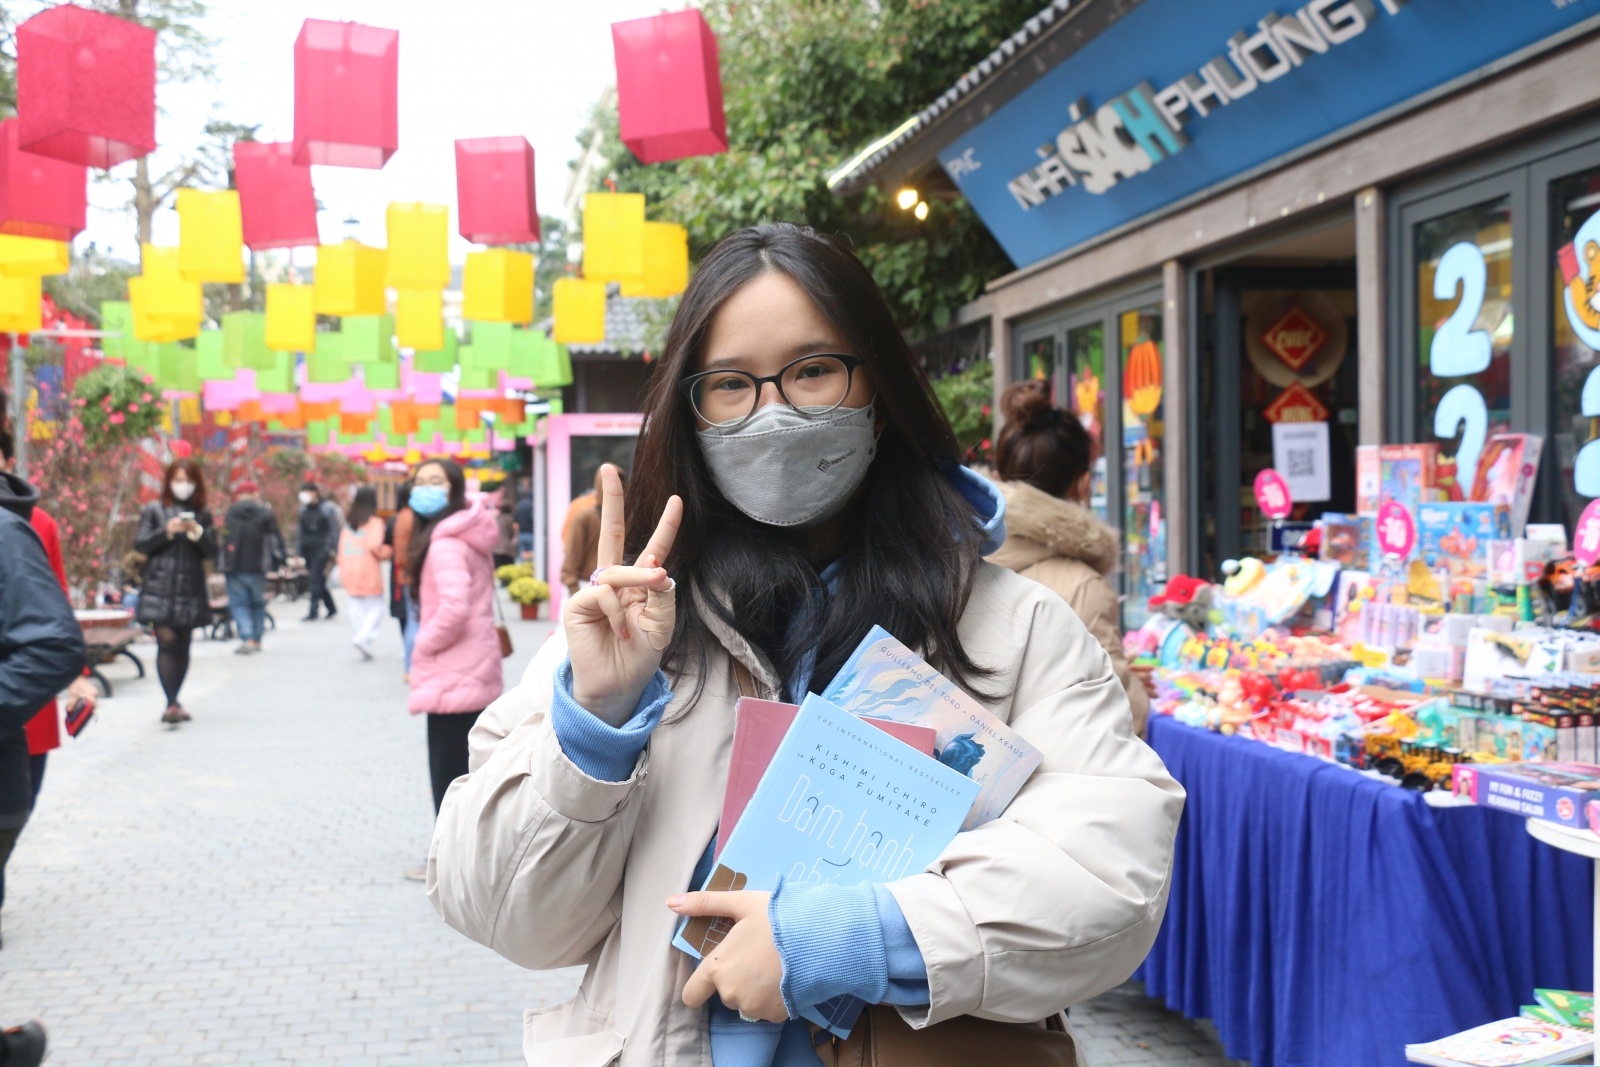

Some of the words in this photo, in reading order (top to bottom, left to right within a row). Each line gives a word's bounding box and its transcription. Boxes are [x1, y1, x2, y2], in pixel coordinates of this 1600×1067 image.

[1007, 145, 1077, 211] NHÀ
[1057, 86, 1183, 195] SÁCH
[1153, 0, 1367, 132] PHƯƠNG
[1430, 241, 1492, 377] 2
[880, 646, 924, 681] GUILLERMO
[924, 679, 938, 693] DEL
[940, 691, 961, 711] TORO
[969, 714, 997, 739] DANIEL
[998, 737, 1025, 759] KRAUS
[809, 756, 846, 781] KOGA
[856, 781, 931, 827] FUMITAKE
[815, 743, 876, 781] KISHIMI
[885, 781, 938, 815] ICHIRO
[817, 715, 833, 727] THE
[836, 726, 904, 767] INTERNATIONAL
[908, 765, 962, 797] BESTSELLER
[1513, 786, 1522, 798] &
[777, 773, 836, 849] Dám
